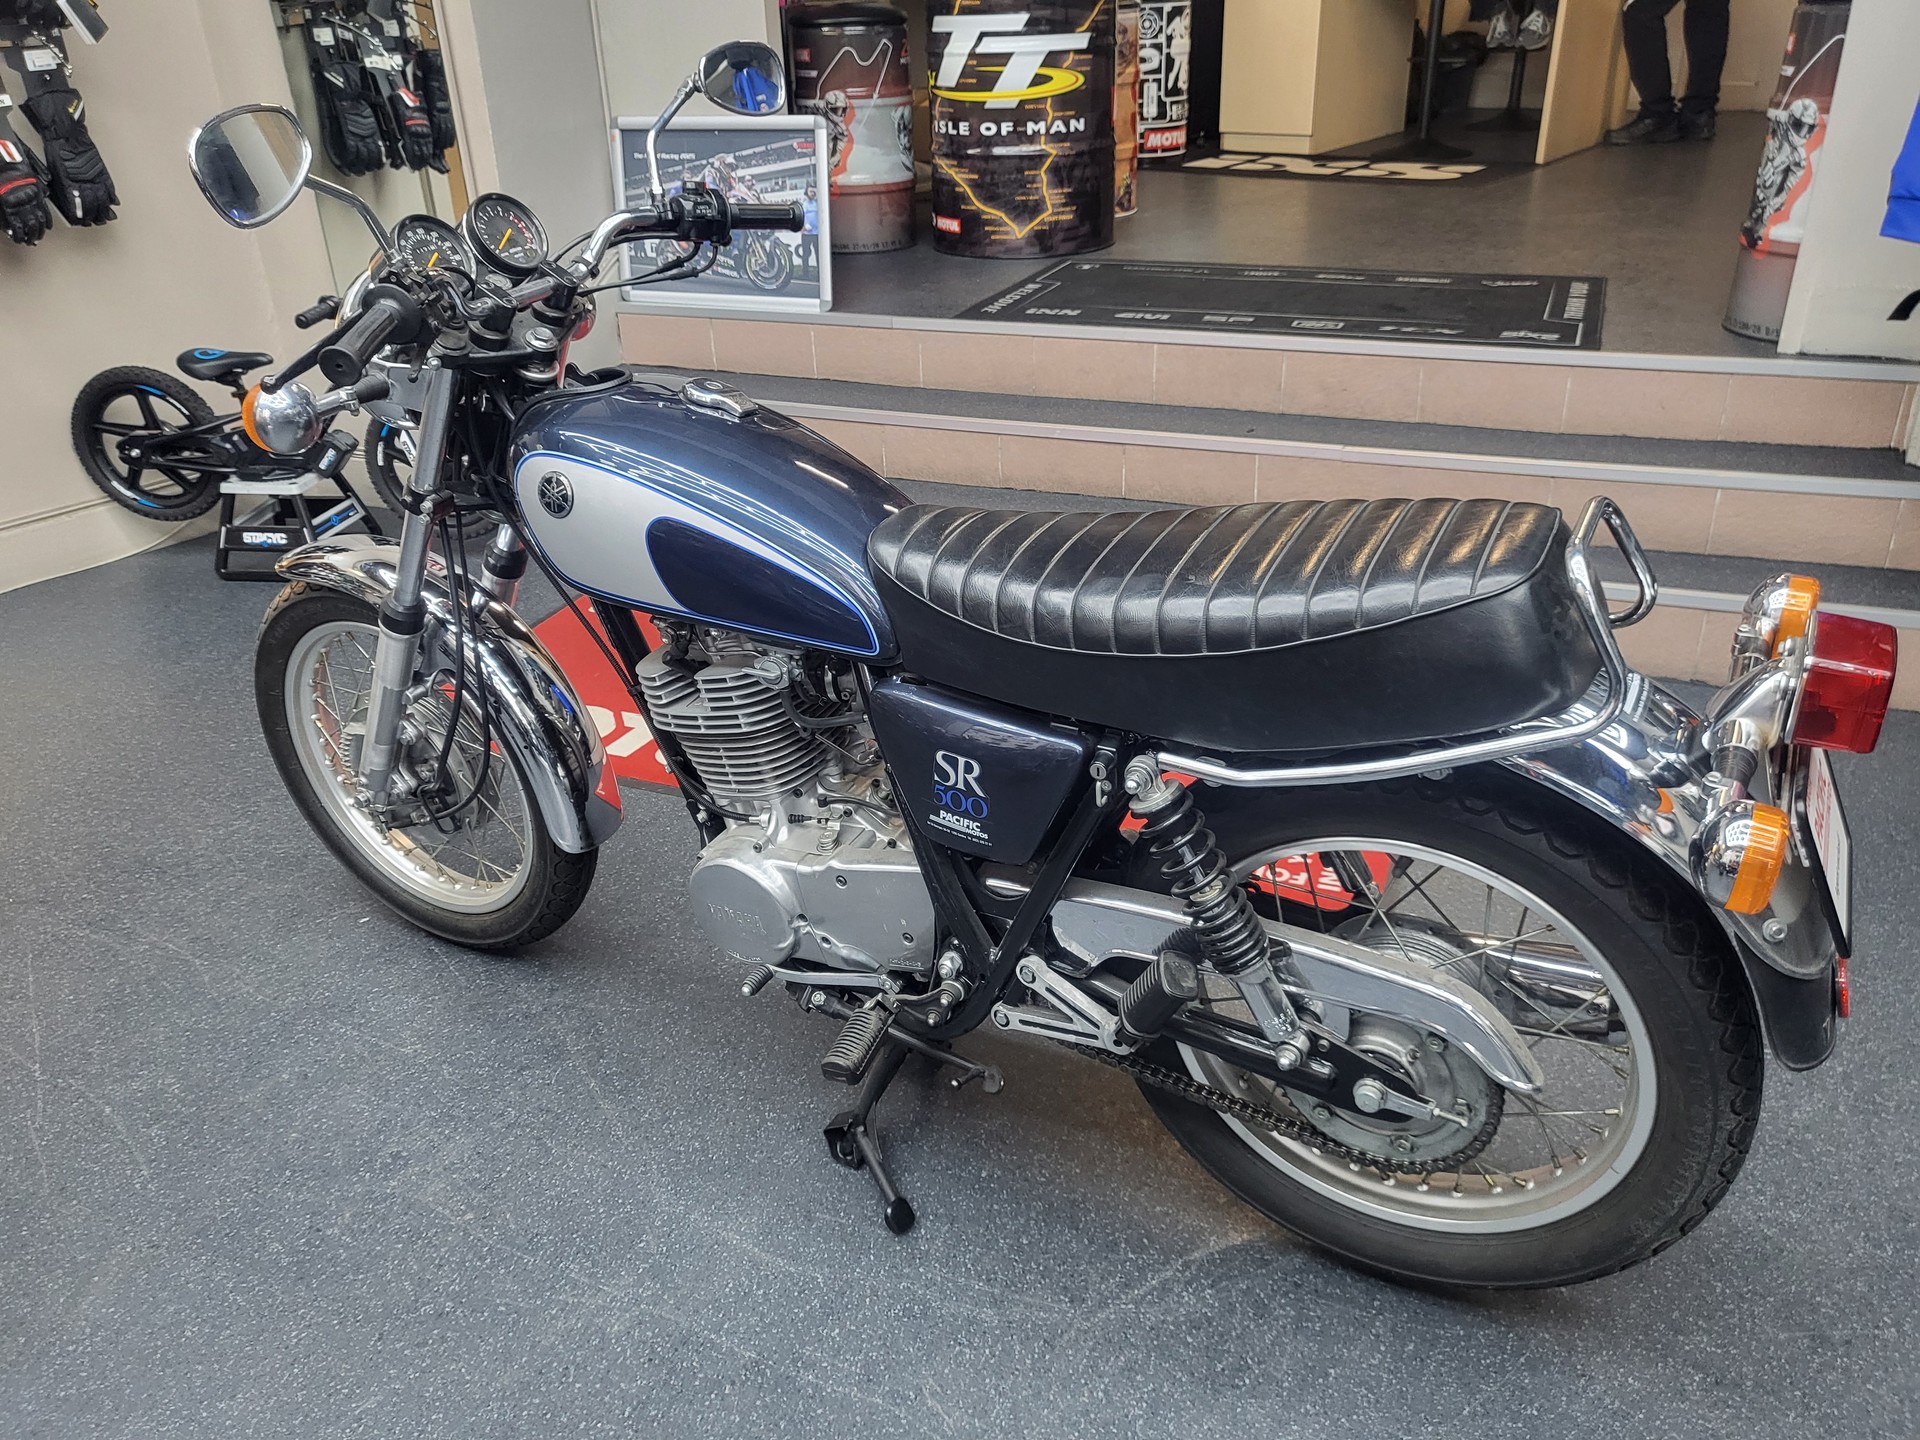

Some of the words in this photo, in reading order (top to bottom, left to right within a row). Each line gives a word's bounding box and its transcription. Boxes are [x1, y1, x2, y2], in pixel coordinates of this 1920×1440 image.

[931, 13, 1092, 109] TT
[934, 119, 970, 136] ISLE
[980, 121, 1014, 137] OF
[1026, 117, 1086, 136] MAN
[1147, 130, 1186, 147] MOTU
[934, 750, 987, 798] SR
[933, 785, 989, 819] 500
[940, 810, 981, 832] PACIFIC
[965, 828, 989, 840] MOTOS
